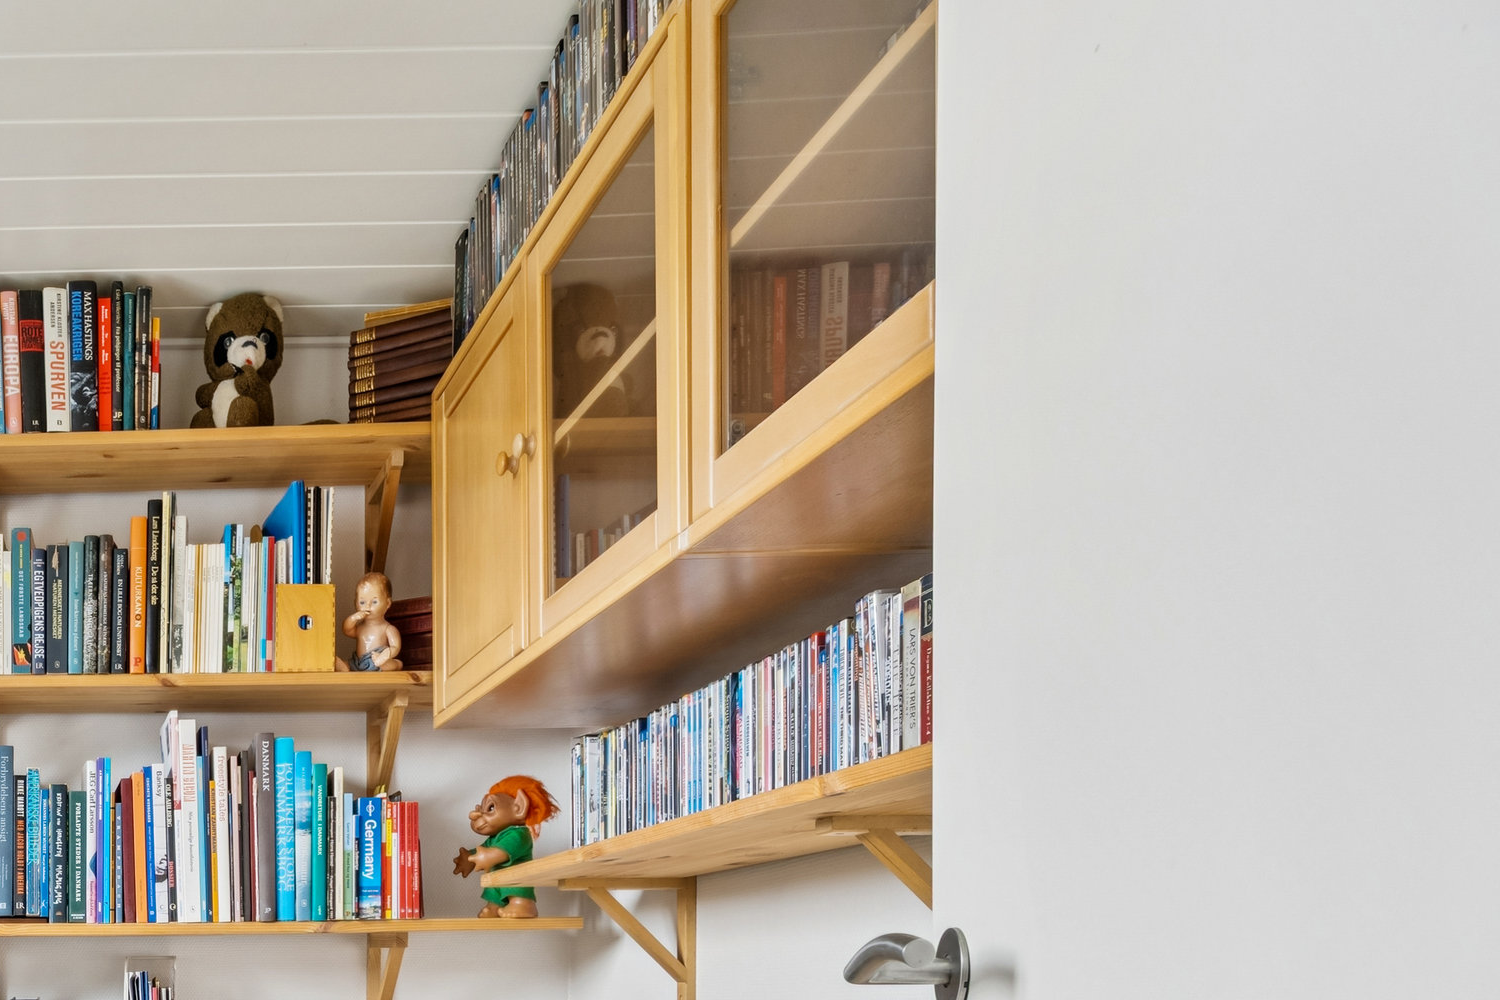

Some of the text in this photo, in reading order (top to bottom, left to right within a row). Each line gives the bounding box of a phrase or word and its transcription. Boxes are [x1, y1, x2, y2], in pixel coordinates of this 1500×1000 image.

[21, 327, 43, 338] ROTE
[71, 291, 83, 361] KOREAKRIGEN
[84, 291, 92, 361] MAX HASTINGS
[3, 335, 20, 397] EUROPA
[50, 340, 66, 410] SPURVEN
[34, 570, 45, 659] EGTVEDPIGENS REJSE
[134, 567, 143, 628] KULTURKANON
[908, 628, 917, 729] LARS VON TRIER'S
[155, 771, 164, 797] Banksy
[183, 744, 195, 775] MARTIN
[217, 755, 226, 797] freestyle
[262, 741, 270, 791] DANMARK
[0, 756, 9, 843] Forbrydelsens ansigt
[276, 764, 287, 892] DANMARKSBOG
[285, 763, 295, 891] POLITIKENS STORE
[362, 819, 377, 880] Germany
